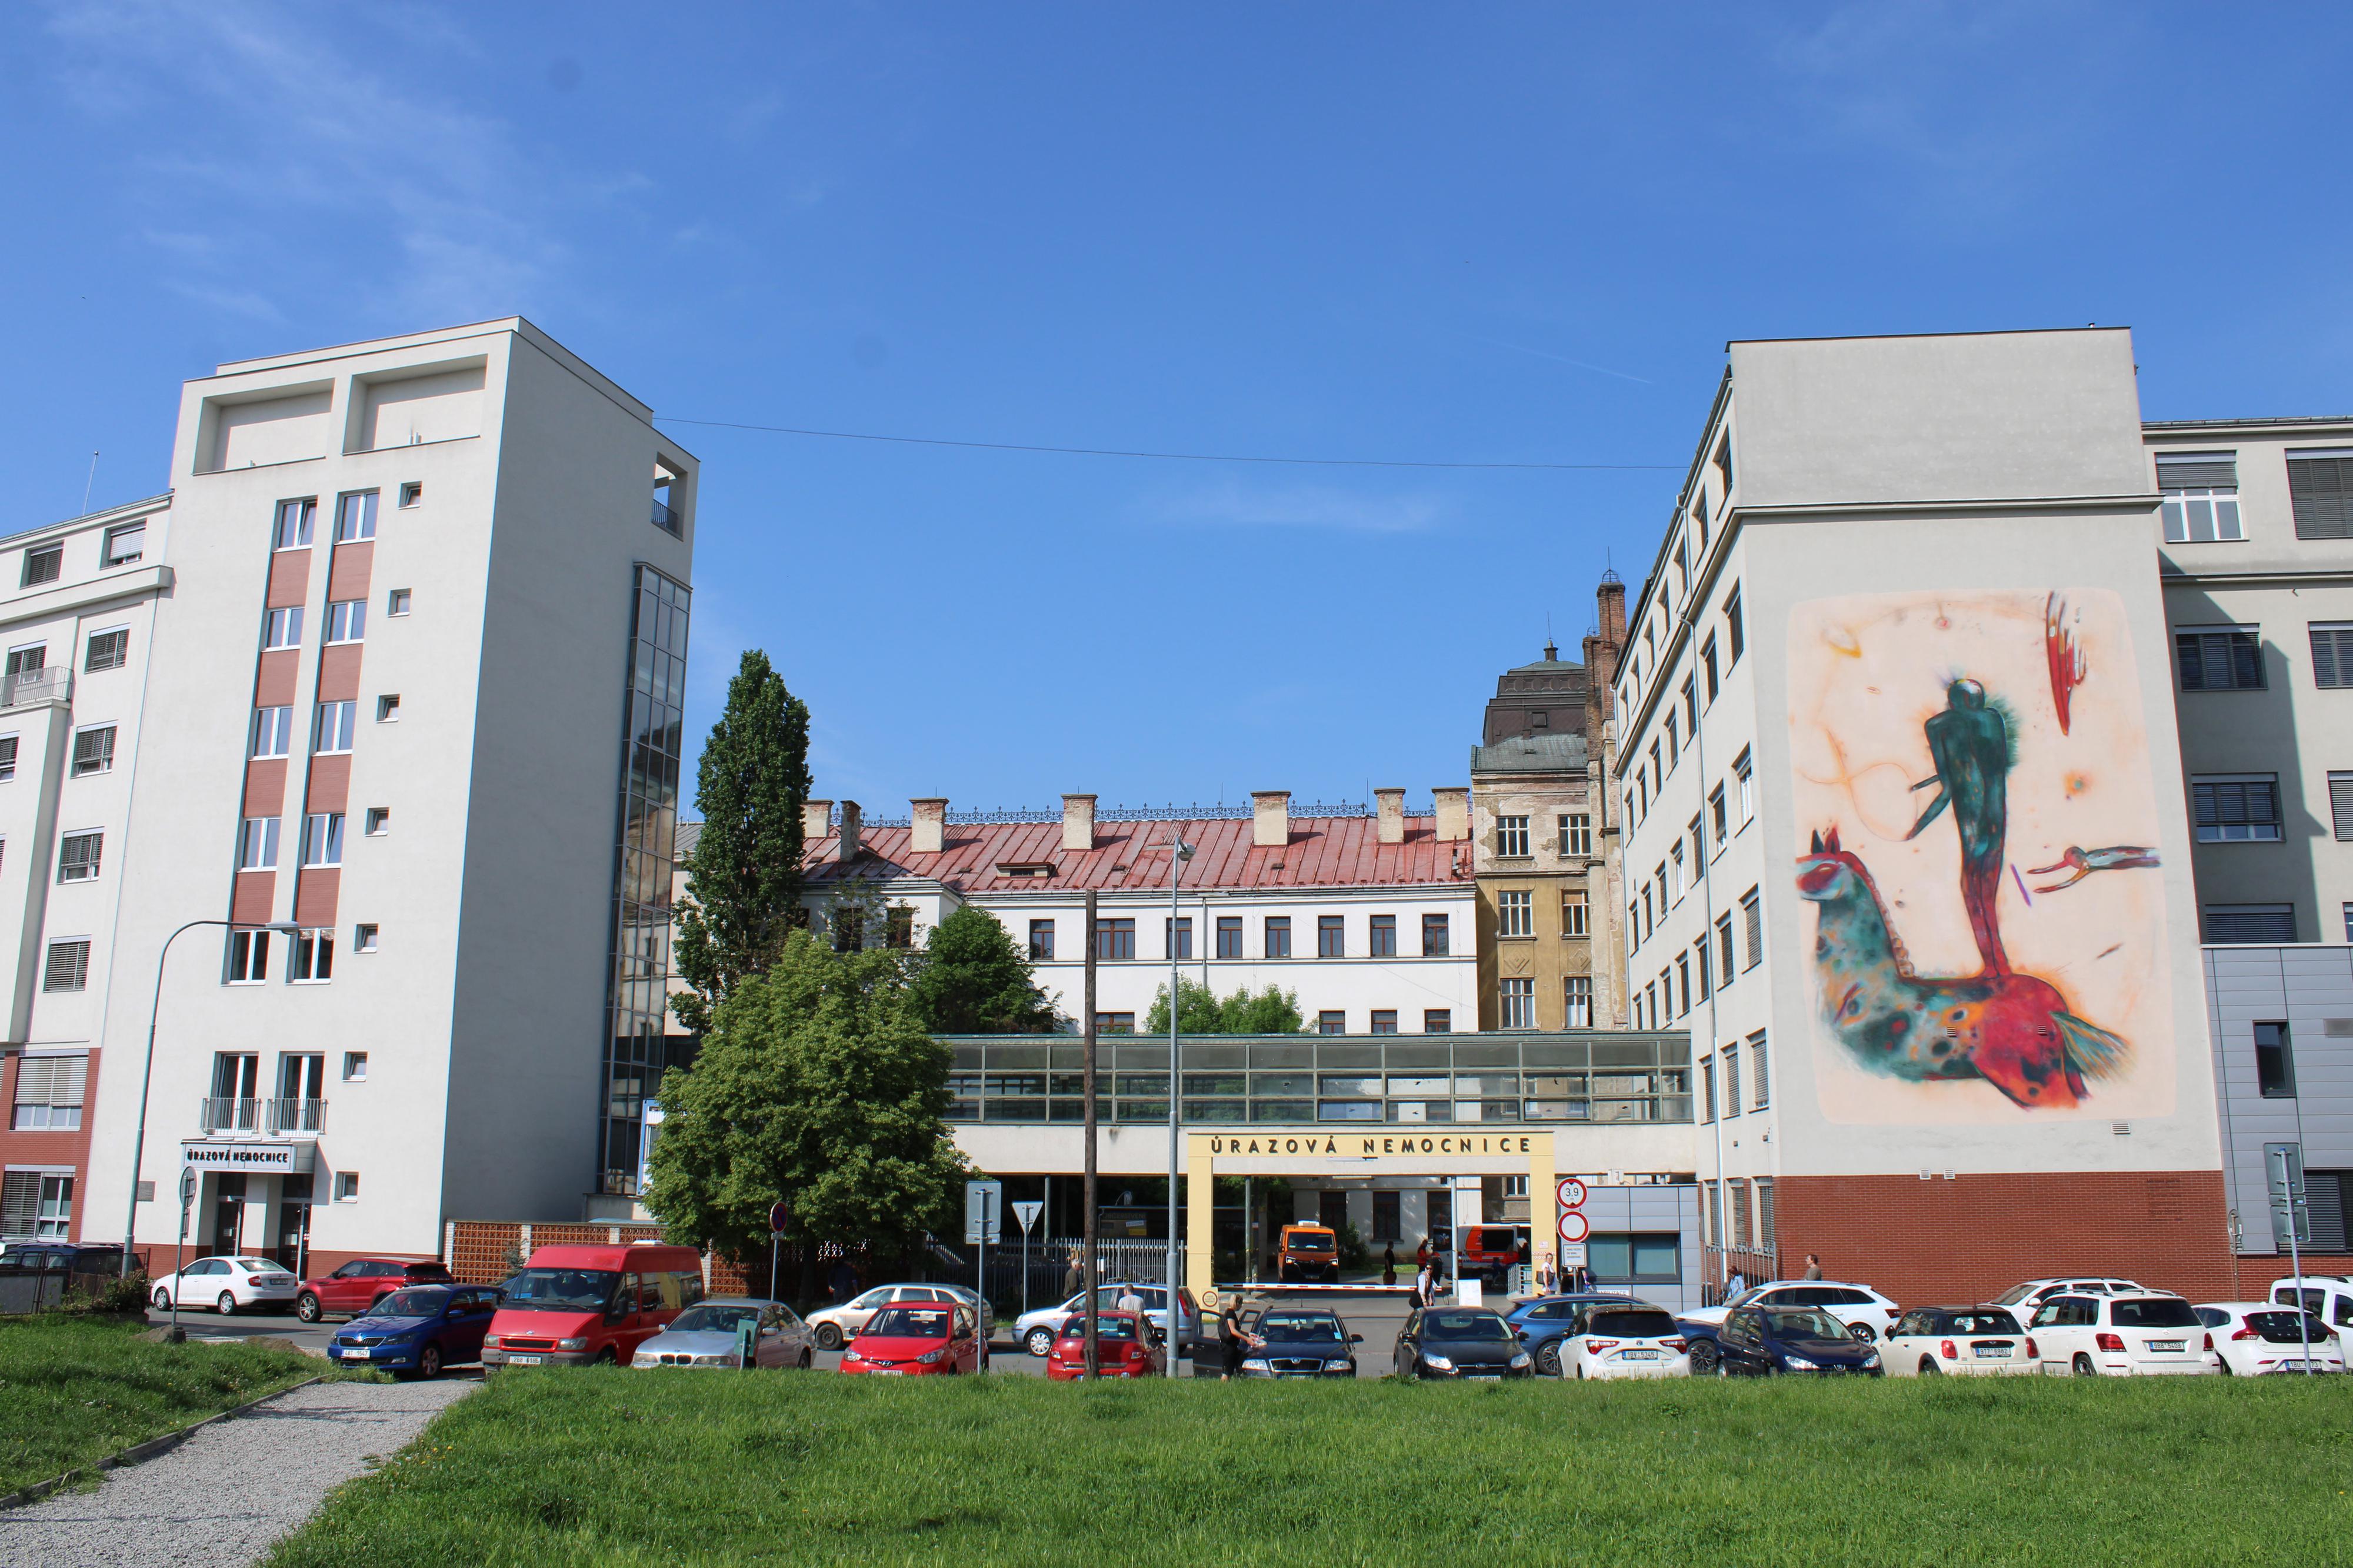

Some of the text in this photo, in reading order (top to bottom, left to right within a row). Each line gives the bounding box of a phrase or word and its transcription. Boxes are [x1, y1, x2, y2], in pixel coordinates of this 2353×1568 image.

[1211, 1135, 1529, 1153] ÚRAZOVÁ NEMOCNICE
[188, 1149, 288, 1163] ÚRAZOVÁ NEMOCNICE
